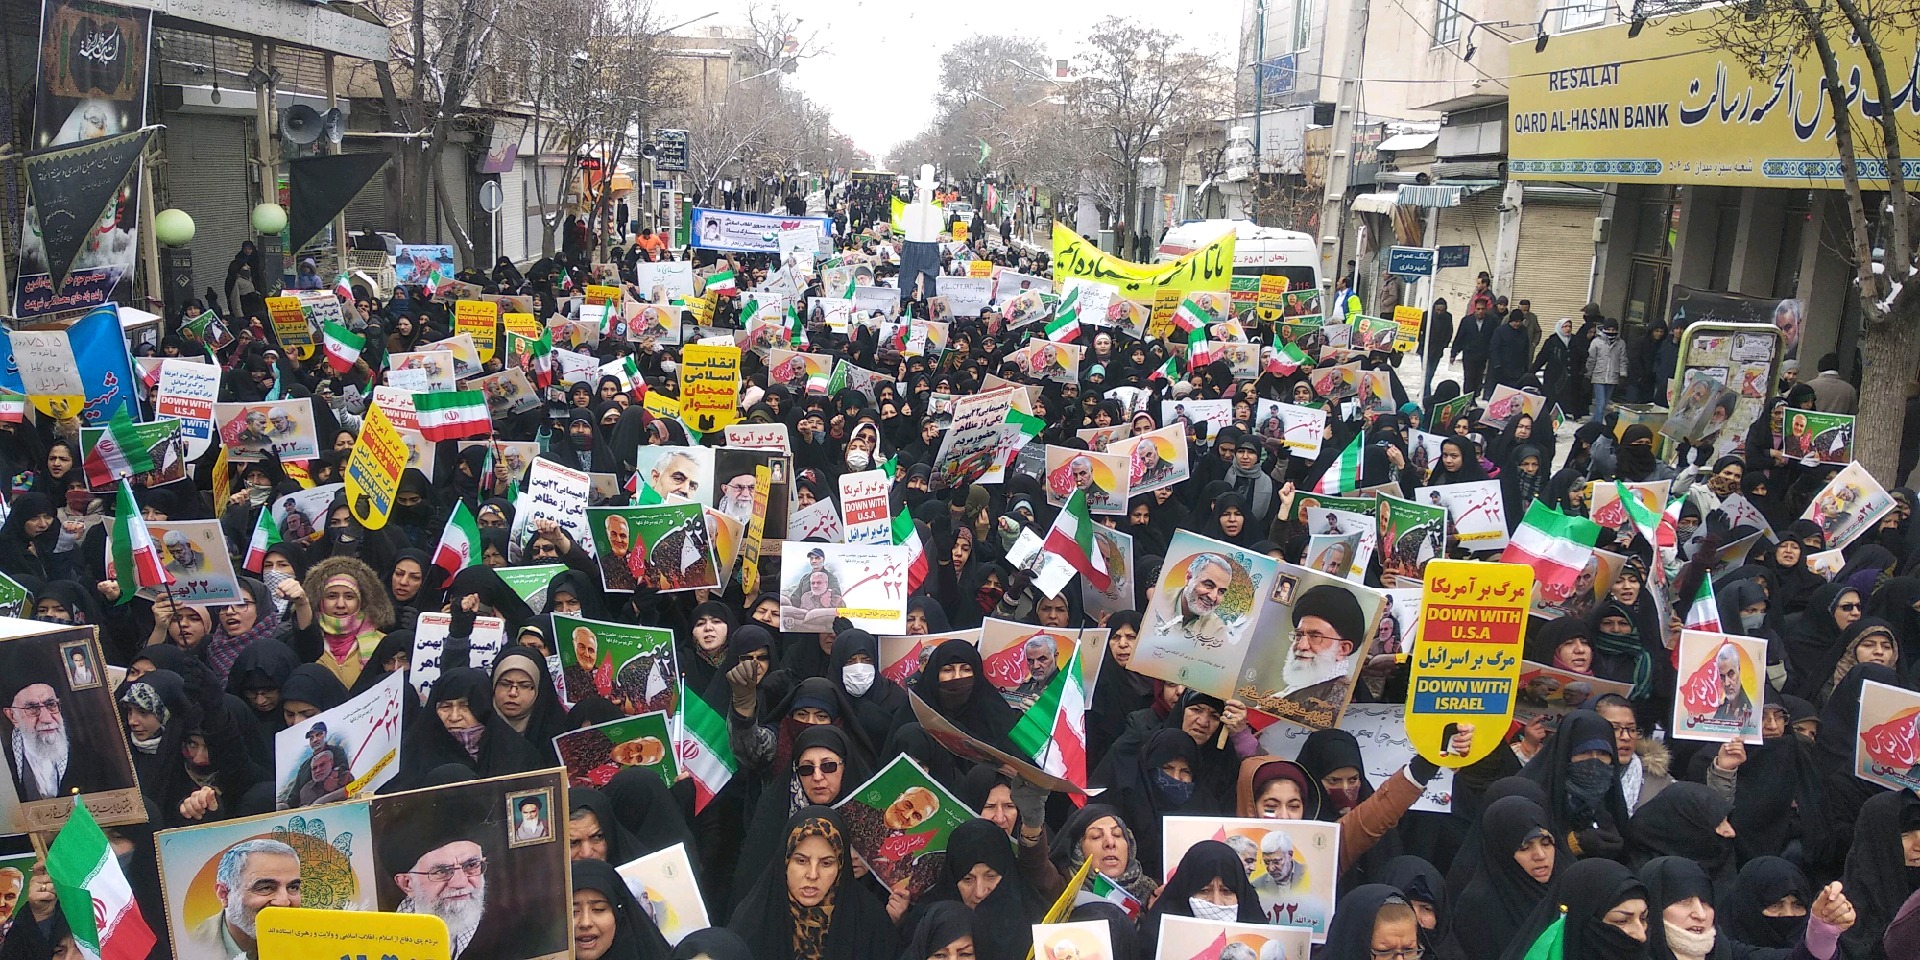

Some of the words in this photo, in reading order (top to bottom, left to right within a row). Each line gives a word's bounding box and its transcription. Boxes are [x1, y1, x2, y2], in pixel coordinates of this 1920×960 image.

[1549, 63, 1620, 91] RESALAT
[1679, 61, 1752, 126] رسالت
[1515, 112, 1547, 133] QARD
[1551, 107, 1619, 132] AL-HASAN
[1624, 103, 1669, 128] BANK
[1684, 160, 1691, 172] کد
[1734, 160, 1753, 175] شعبه
[1268, 254, 1288, 263] زنجان
[1393, 253, 1414, 261] عمومی
[1398, 263, 1427, 272] شهرداری
[1296, 282, 1310, 290] 115
[685, 357, 736, 368] انقلاب
[684, 370, 735, 383] اسلامی
[683, 384, 735, 399] همچنان
[161, 396, 188, 407] DOWN
[189, 399, 212, 410] WITH
[376, 393, 398, 407] آمریکا
[683, 398, 734, 412] استوار
[174, 407, 196, 416] U.S.A
[971, 408, 981, 416] ۲۲
[980, 402, 1009, 416] راهپیمایی
[186, 420, 209, 429] WITH
[370, 411, 389, 438] آمریکا
[955, 413, 973, 422] بهمن
[978, 419, 987, 430] از
[987, 416, 1003, 426] یکی
[1218, 418, 1229, 428] ۲۲
[953, 422, 978, 436] مظاهر
[1308, 428, 1318, 440] ۲۲
[729, 431, 754, 445] آمریکا
[757, 435, 764, 444] بر
[764, 432, 784, 442] مرگ
[954, 437, 973, 448] مردم
[973, 430, 996, 444] حضور
[364, 424, 386, 450] DOWN
[382, 447, 402, 474] WITH
[392, 442, 404, 462] مرگ
[356, 445, 377, 471] اسرائیل
[371, 444, 388, 470] U.S.A
[353, 457, 374, 485] DOWN
[371, 479, 390, 507] WITH
[357, 473, 379, 505] ISRAEL
[532, 477, 549, 490] بهمن
[548, 479, 558, 490] ۲۲
[843, 481, 863, 497] آمریکا
[864, 484, 870, 494] بر
[871, 481, 885, 491] مرگ
[532, 493, 558, 506] مظاهر
[557, 486, 588, 503] راهپیمایی
[1095, 495, 1110, 506] ۲۲
[558, 500, 566, 512] از
[566, 504, 583, 517] یکی
[845, 499, 866, 513] DOWN
[866, 498, 886, 511] WITH
[857, 511, 877, 521] U.S.A
[1484, 509, 1500, 523] ۲۲
[685, 529, 704, 545] ۲۲
[823, 524, 839, 540] ۲۲
[847, 527, 870, 544] اسرائیل
[869, 530, 876, 541] بر
[875, 527, 889, 538] مرگ
[1427, 528, 1441, 545] ۲۲
[650, 513, 700, 566] بهمن
[841, 562, 902, 598] بهمن
[187, 580, 208, 595] ۲۲
[883, 581, 903, 600] ۲۲
[1431, 577, 1477, 600] آمریکا
[1479, 584, 1492, 601] بر
[1494, 582, 1525, 603] مرگ
[1427, 607, 1478, 624] DOWN
[1481, 609, 1521, 624] WITH
[1451, 626, 1491, 640] U.S.A
[617, 641, 668, 687] بهمن
[1418, 646, 1470, 671] اسرائیل
[1469, 653, 1485, 671] بر
[1486, 650, 1516, 671] مرگ
[654, 658, 671, 675] ۲۲
[1417, 680, 1468, 693] DOWN
[1470, 680, 1510, 694] WITH
[1435, 697, 1485, 711] ISRAEL
[385, 713, 399, 742] ۲۲
[1272, 903, 1299, 924] ۲۲
[295, 930, 313, 938] رهبری
[379, 935, 393, 943] اسلام
[395, 935, 399, 943] از
[400, 936, 413, 944] دفاع
